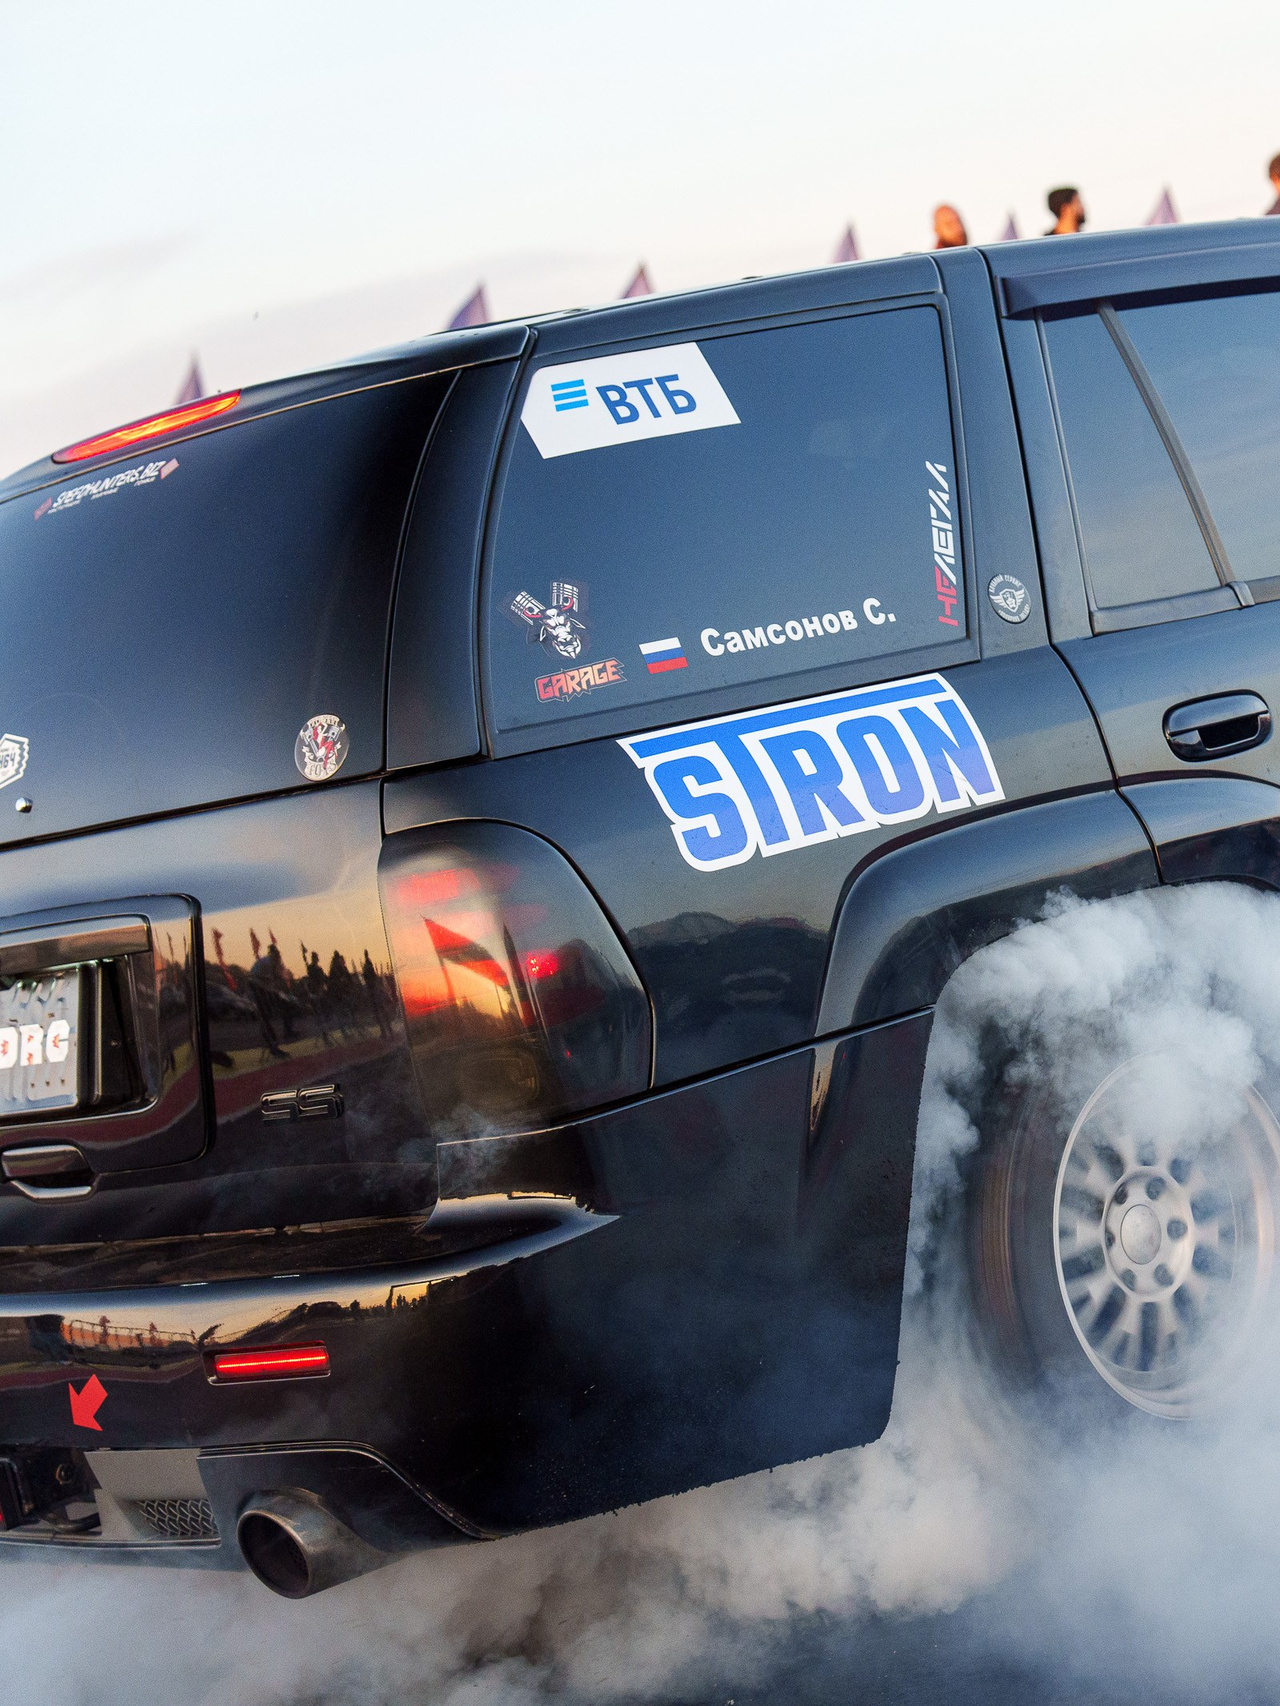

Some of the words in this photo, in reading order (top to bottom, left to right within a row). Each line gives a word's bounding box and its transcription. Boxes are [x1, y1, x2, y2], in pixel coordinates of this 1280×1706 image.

[596, 374, 697, 425] ВТБ
[699, 609, 860, 658] Самсонов
[863, 597, 897, 626] С.
[536, 660, 622, 700] GARAGE
[630, 678, 996, 862] STRON
[260, 1084, 343, 1121] SS
